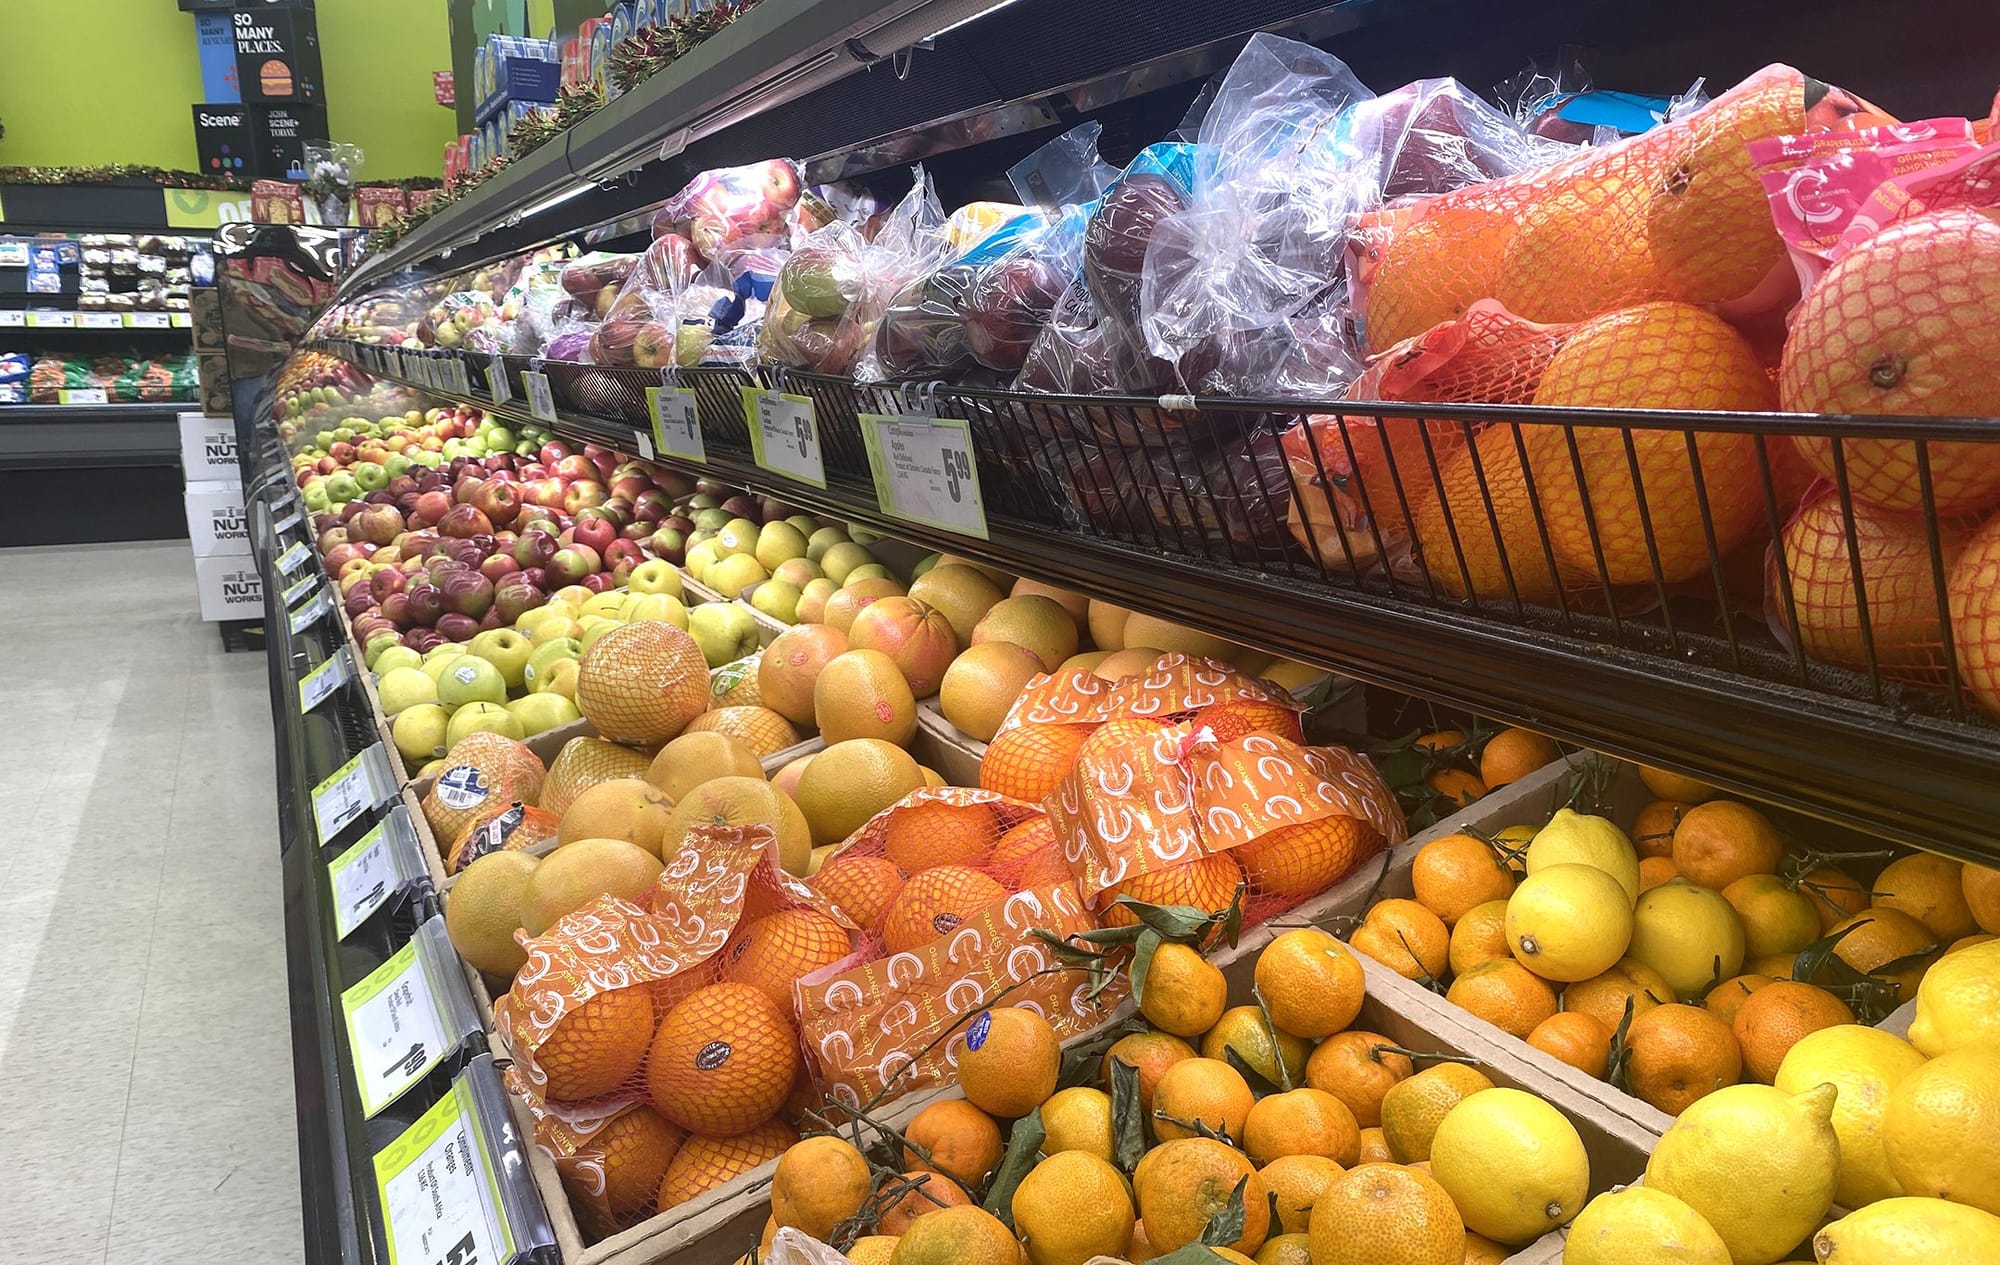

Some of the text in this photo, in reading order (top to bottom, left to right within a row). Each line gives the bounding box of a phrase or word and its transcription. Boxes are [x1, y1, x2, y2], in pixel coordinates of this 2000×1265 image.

[233, 13, 252, 26] SO
[235, 27, 274, 40] MANY
[213, 518, 248, 531] NUT
[223, 582, 260, 595] NUT
[225, 595, 262, 603] WORKS
[1296, 781, 1321, 812] ORANGES
[929, 946, 942, 982] ORANGE
[982, 957, 1002, 995] ORANGE
[854, 1066, 873, 1100] ORANG
[444, 1142, 457, 1175] Oranges
[456, 1129, 474, 1176] Compliments
